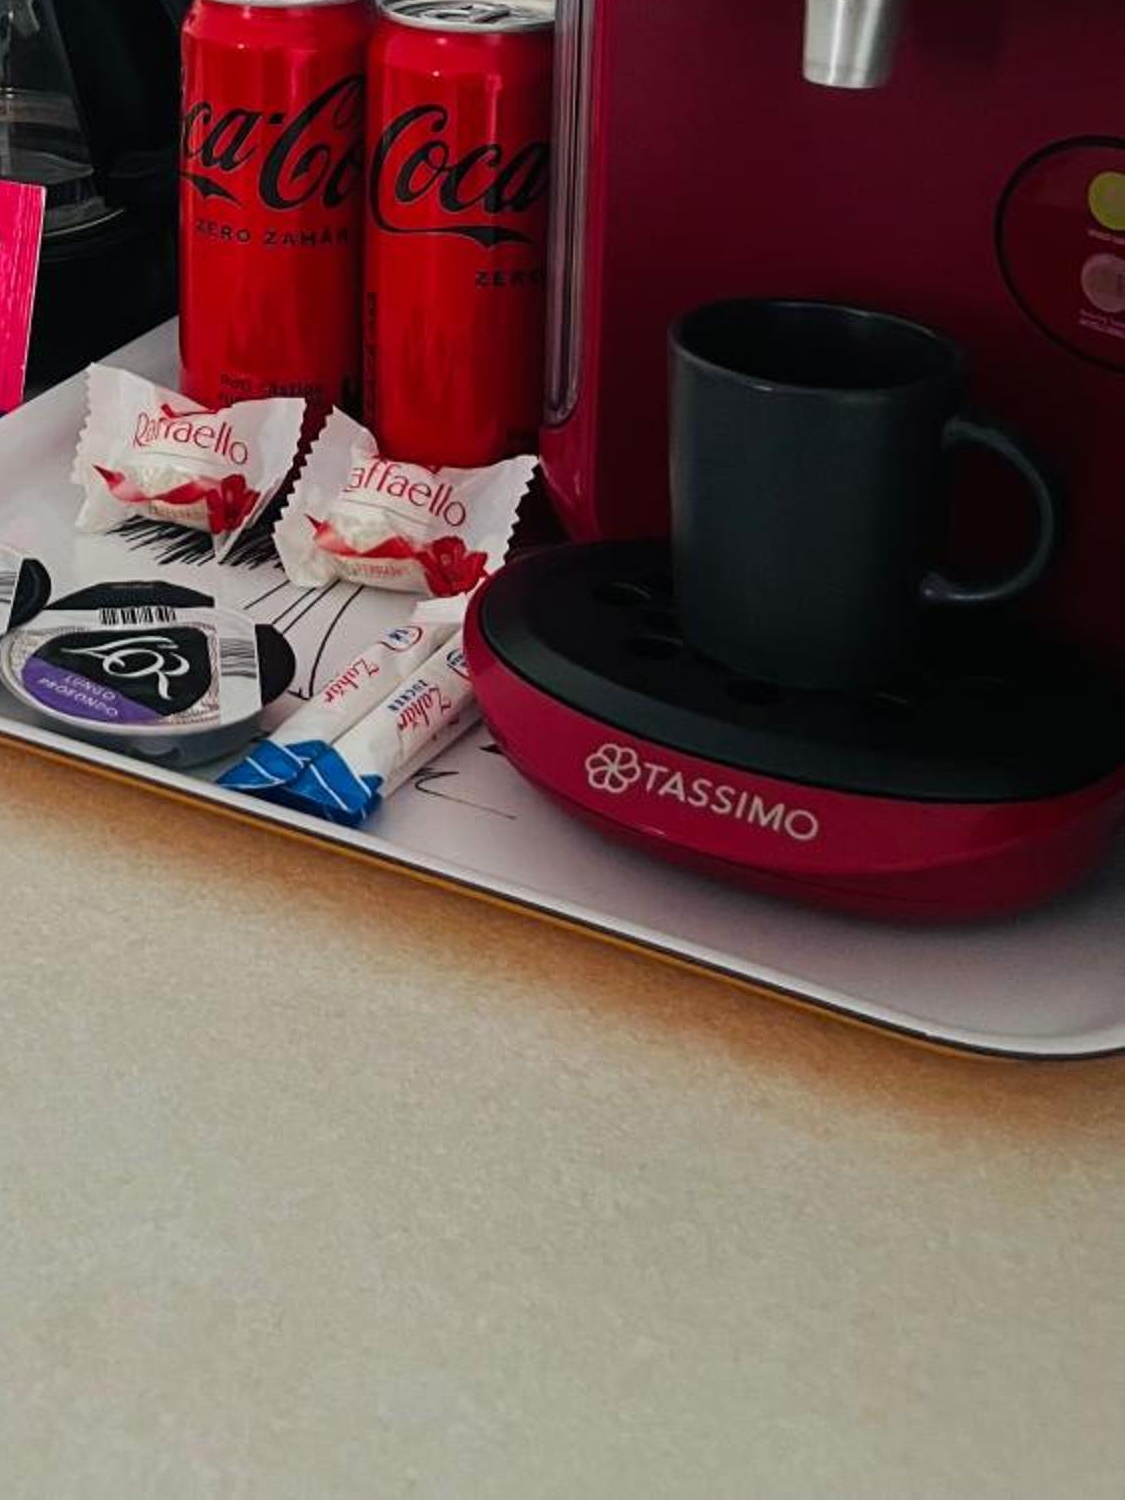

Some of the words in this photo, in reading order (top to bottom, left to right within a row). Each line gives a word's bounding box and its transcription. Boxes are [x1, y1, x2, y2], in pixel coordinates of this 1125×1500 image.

[196, 217, 251, 243] ZERO
[349, 458, 467, 527] affaello
[37, 677, 119, 717] PROFONDO
[64, 675, 117, 700] LUNGO
[643, 761, 819, 841] TASSIMO
